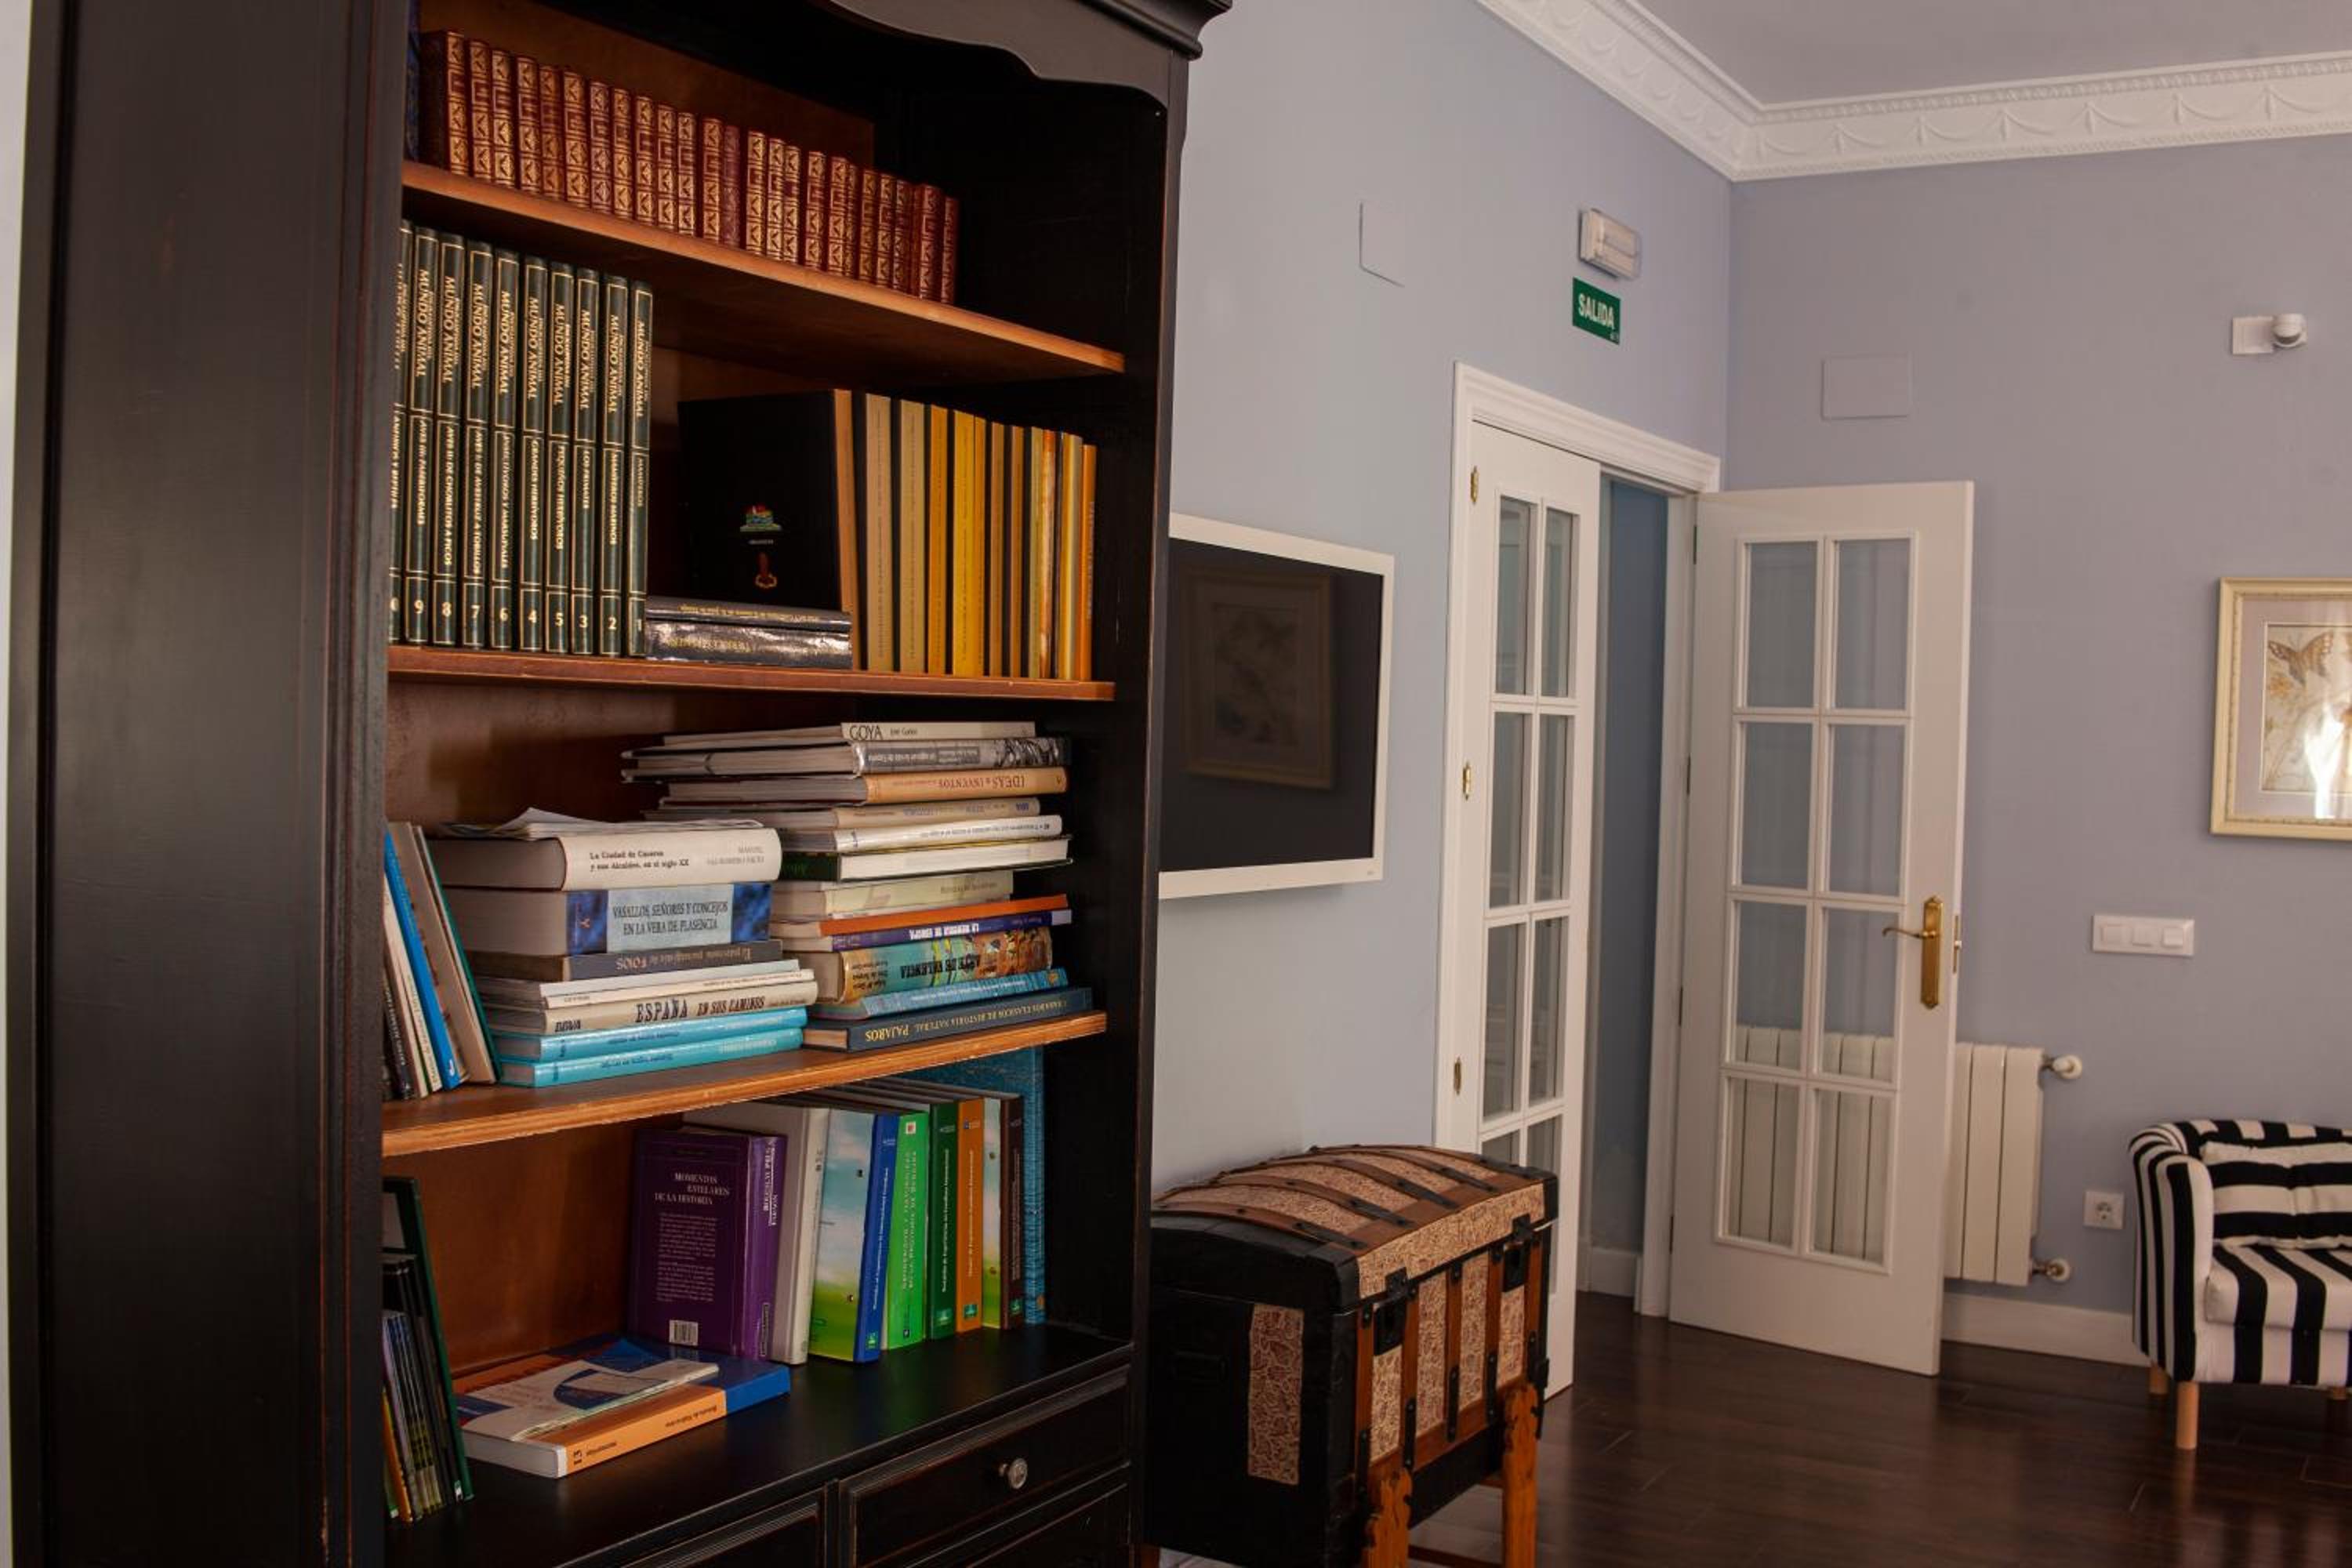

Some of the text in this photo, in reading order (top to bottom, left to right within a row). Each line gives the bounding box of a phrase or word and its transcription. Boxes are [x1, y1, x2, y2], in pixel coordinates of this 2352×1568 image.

[1578, 292, 1616, 330] SALIDA
[416, 269, 429, 376] MUNDO ANIMAL
[443, 276, 455, 383] MUNDO ANIMAL
[472, 284, 483, 388] MUNDO ANIMAL
[499, 292, 510, 394] MUNDO ANIMAL
[528, 296, 538, 399] MUNDO ANIMAL
[554, 304, 564, 405] MUNDO ANIMAL
[579, 310, 590, 410] MUNDO ANIMAL
[608, 315, 619, 413] MUNDO ANIMAL
[636, 321, 645, 418] MUNDO ANIMAL
[414, 600, 424, 614] 9
[441, 602, 452, 617] 8
[471, 604, 481, 619] 7
[499, 609, 508, 622] 6
[528, 611, 537, 623] 4
[555, 612, 564, 626] 5
[579, 615, 588, 628] 3
[608, 617, 617, 630] 2
[849, 725, 883, 741] GOYA
[939, 777, 984, 789] INVENTOS
[993, 775, 1025, 788] IDEAS
[623, 918, 718, 935] EN LA VERA DE PLASENCIA
[900, 962, 943, 978] VALENCIA
[634, 996, 688, 1023] ESPAÑA
[697, 1004, 710, 1018] EN
[712, 1001, 728, 1014] SUS
[728, 996, 766, 1013] CAMINOS
[950, 1012, 985, 1025] HISTORIA
[674, 1172, 718, 1184] MOMENTOS
[677, 1193, 713, 1206] HISTORIA
